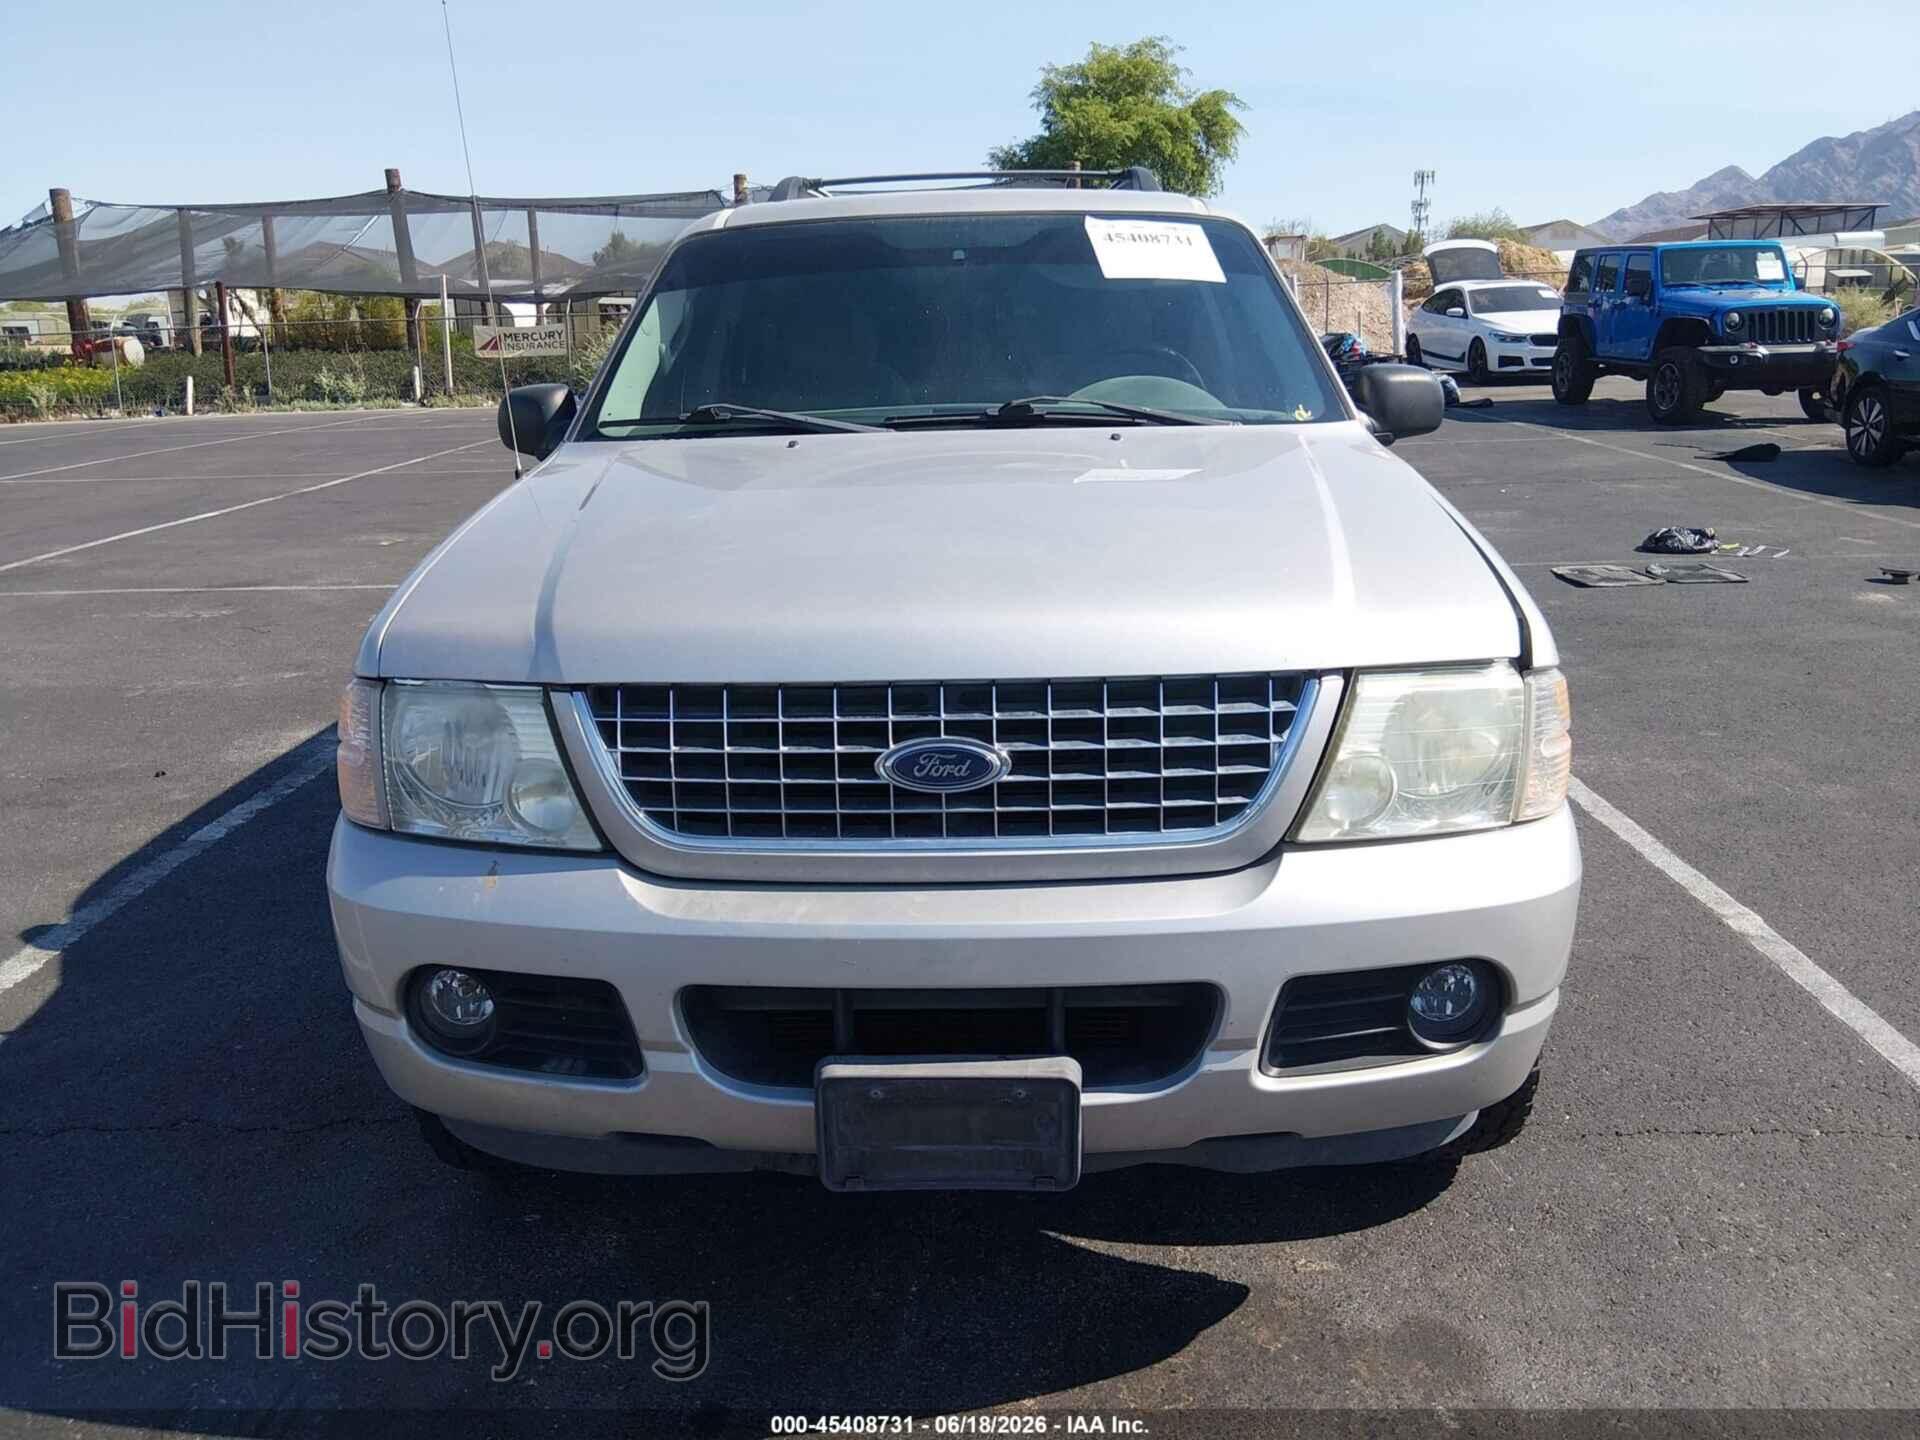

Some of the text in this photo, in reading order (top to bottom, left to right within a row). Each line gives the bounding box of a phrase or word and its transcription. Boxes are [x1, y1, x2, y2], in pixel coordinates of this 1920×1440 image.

[503, 330, 563, 342] MERCURY
[503, 340, 565, 351] INSURANCE
[913, 752, 972, 777] Ford
